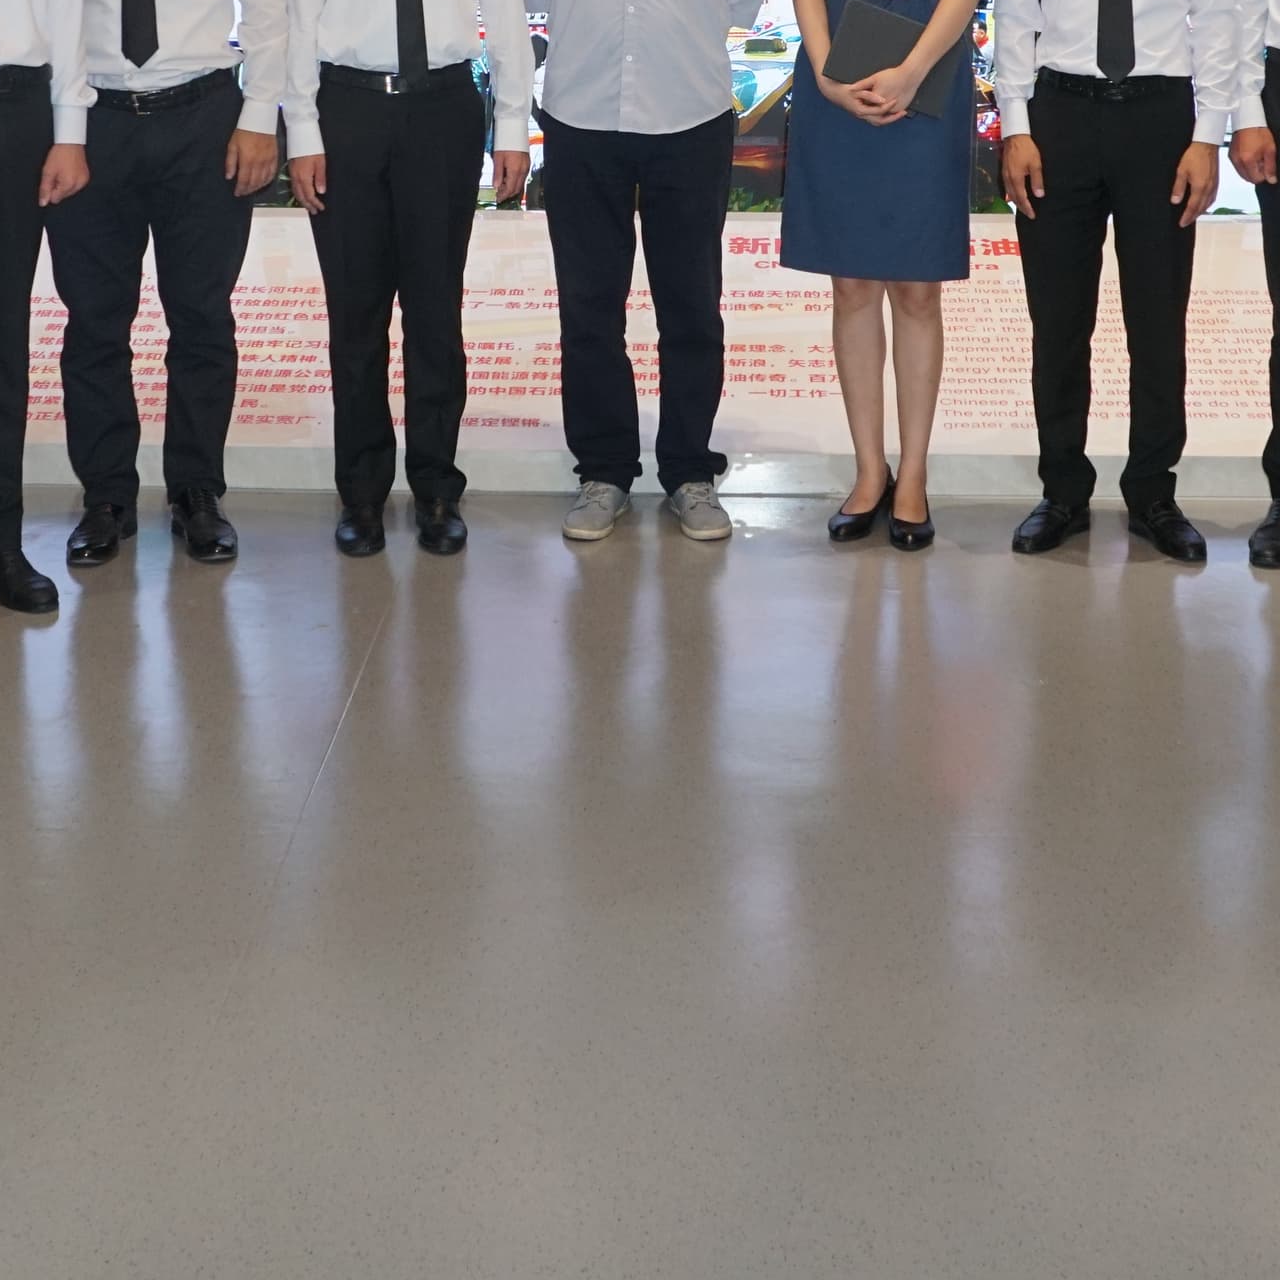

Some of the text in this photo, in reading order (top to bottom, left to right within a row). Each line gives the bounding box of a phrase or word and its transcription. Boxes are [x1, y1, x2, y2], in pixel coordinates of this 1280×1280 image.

[721, 290, 833, 298] 石破天惊的石
[461, 301, 560, 309] 了一条为中
